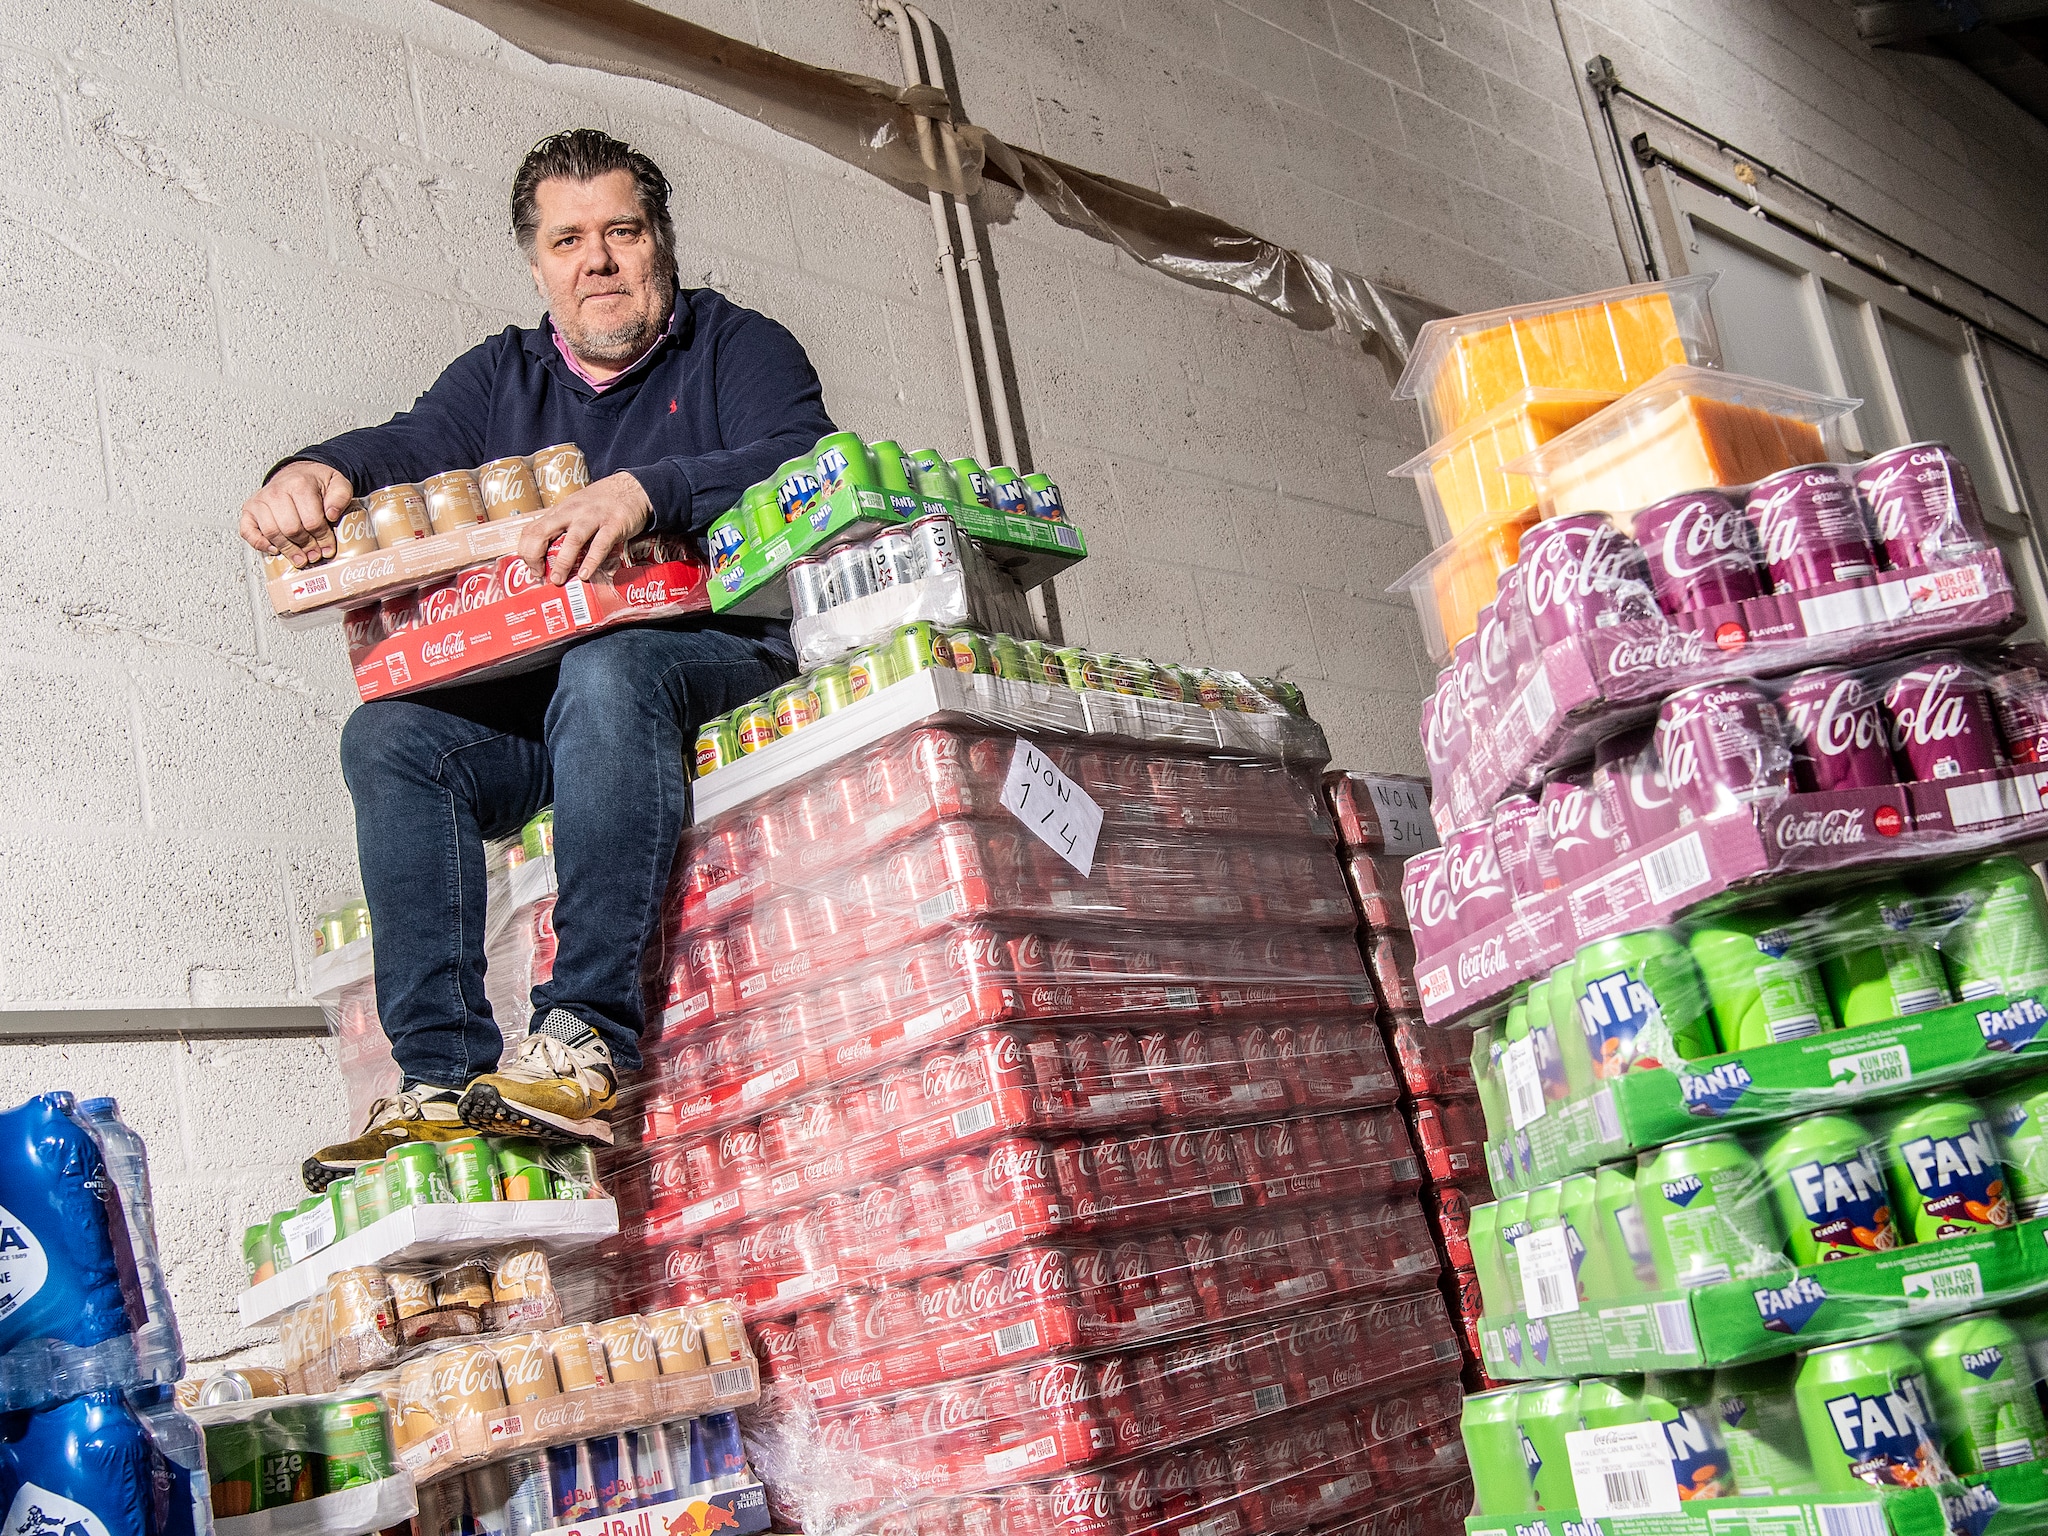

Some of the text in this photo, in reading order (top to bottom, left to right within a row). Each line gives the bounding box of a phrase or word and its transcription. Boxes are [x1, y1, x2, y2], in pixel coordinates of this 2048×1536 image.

[890, 495, 917, 511] FANTA
[922, 501, 949, 516] FANTA
[808, 503, 833, 528] FANTA
[339, 554, 396, 588] Coca-Cola
[720, 564, 745, 588] FANTA
[1527, 524, 1627, 616] Cola
[1933, 573, 1956, 587] NUR
[305, 577, 326, 588] KUN FOR
[307, 583, 328, 595] EXPORT
[626, 580, 668, 606] Coca-Cola
[1938, 585, 1980, 602] EXPORT
[421, 630, 467, 664] Coca-Cola
[1608, 628, 1708, 677] Coca-Cola
[1789, 681, 1826, 696] Cherry
[1026, 750, 1071, 803] NON
[1377, 786, 1418, 810] NON
[1776, 807, 1867, 850] Coca-Cola
[1408, 862, 1431, 877] Cherry
[771, 950, 811, 983] Coca-Cola
[1458, 934, 1510, 989] Coca-Cola
[1032, 986, 1074, 1007] Coca-Cola
[1977, 999, 2048, 1037] FANTA
[836, 1036, 872, 1064] Coca-Cola
[1858, 1051, 1902, 1071] KUN FOR
[1679, 1061, 1753, 1101] FANTA
[1861, 1065, 1904, 1085] EXPORT
[681, 1095, 713, 1119] Coca-Cola
[804, 1152, 844, 1183] Coca-Cola
[1661, 1174, 1703, 1199] FANTA
[1927, 1195, 1961, 1213] exotic
[1814, 1220, 1848, 1238] exotic
[876, 1246, 911, 1270] Coca-Cola
[1930, 1267, 1974, 1289] KUN FOR
[1753, 1276, 1827, 1317] FANTA
[560, 1332, 578, 1341] Coke
[1961, 1347, 2001, 1371] FANTA
[840, 1360, 883, 1390] Coca-Cola
[534, 1400, 587, 1431] Coca-Cola
[1120, 1412, 1160, 1441] Coca-Cola
[505, 1424, 521, 1435] EXPORT
[1037, 1446, 1054, 1458] EXPORT
[1853, 1456, 1886, 1475] exotic
[1946, 1484, 1997, 1524] FANTA
[1070, 1521, 1106, 1535] ORIGINAL
